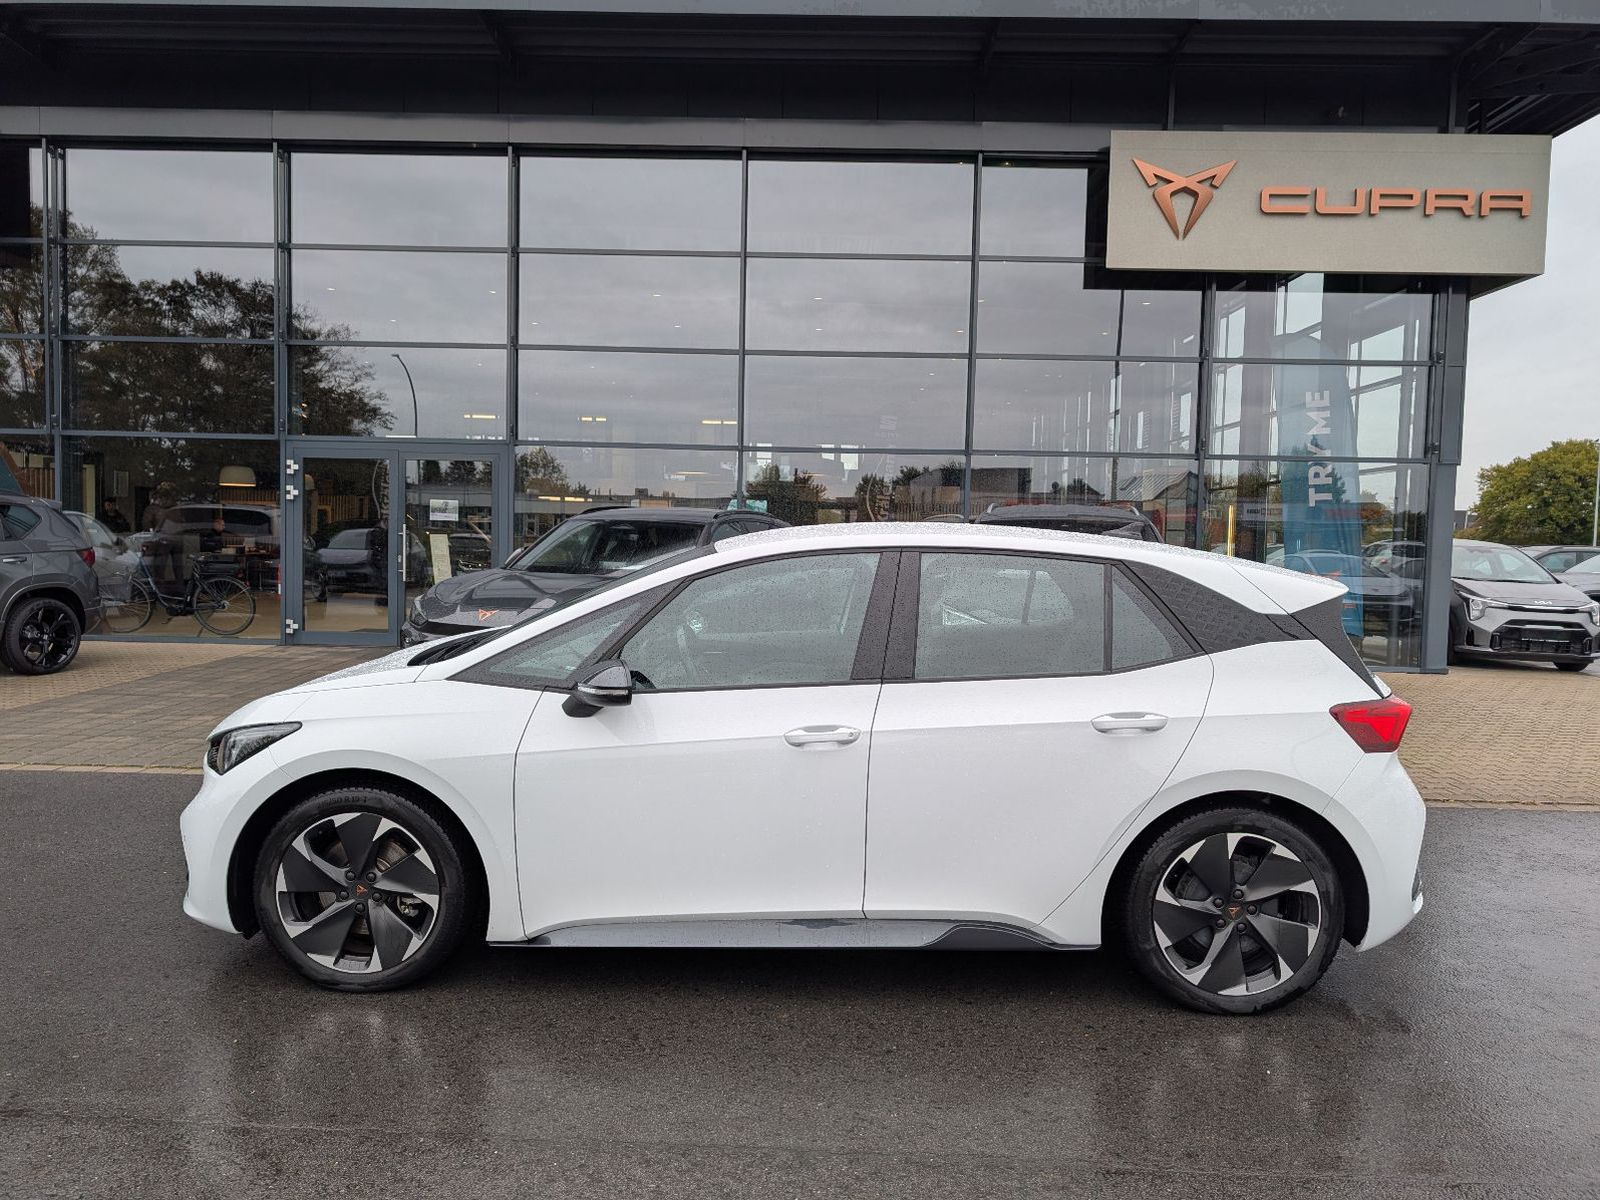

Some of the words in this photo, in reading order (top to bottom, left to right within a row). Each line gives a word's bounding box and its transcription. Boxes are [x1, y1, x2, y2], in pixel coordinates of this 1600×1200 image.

[1260, 186, 1532, 218] CUPRA
[1306, 390, 1332, 435] ME
[1307, 443, 1333, 508] TRY
